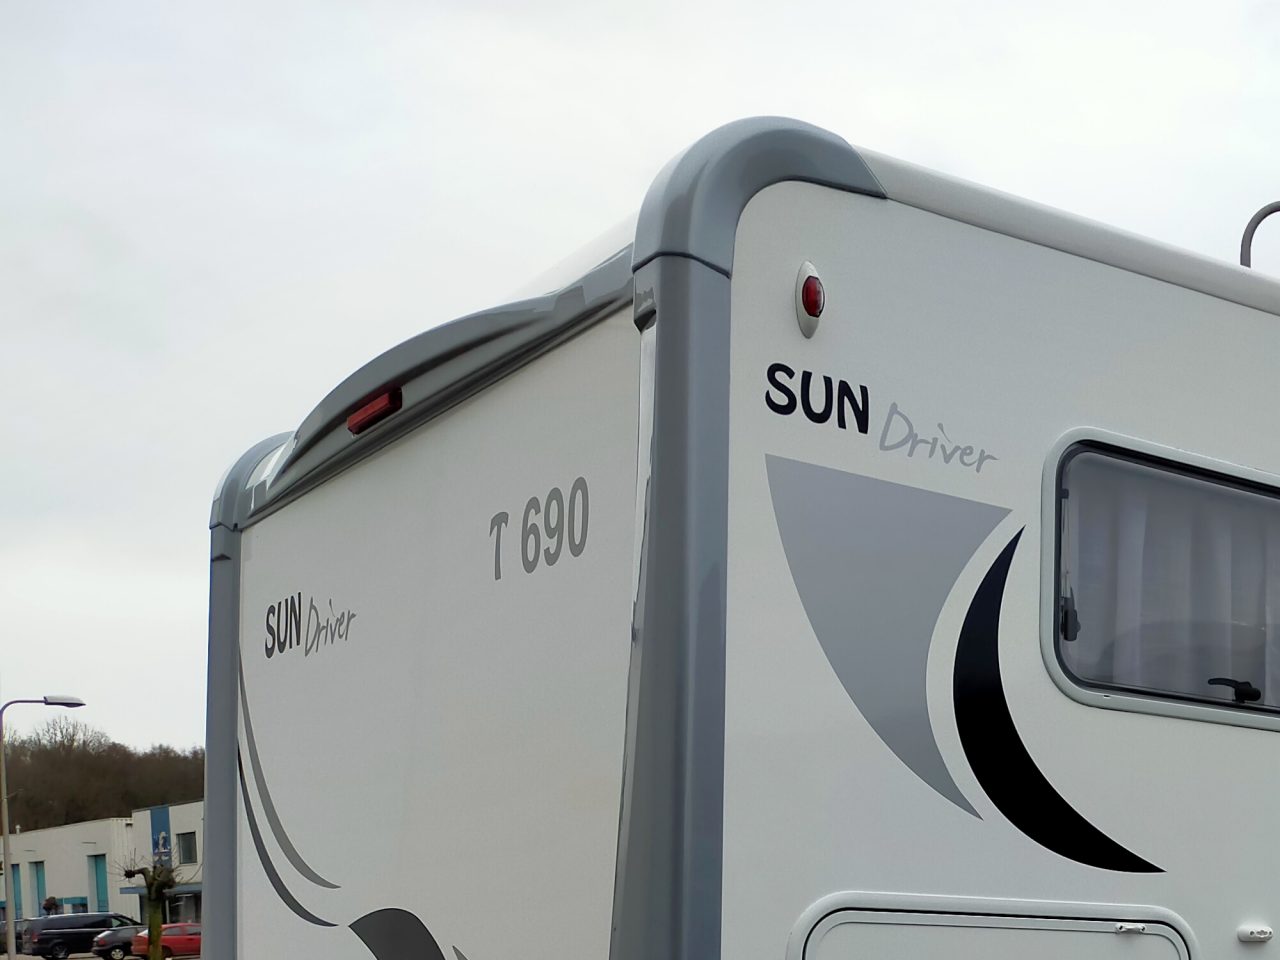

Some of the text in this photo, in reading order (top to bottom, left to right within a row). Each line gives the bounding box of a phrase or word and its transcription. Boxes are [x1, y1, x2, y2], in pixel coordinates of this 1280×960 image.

[765, 363, 999, 473] SUN Driver
[489, 476, 589, 580] T 690
[265, 591, 357, 659] SUN Driver
